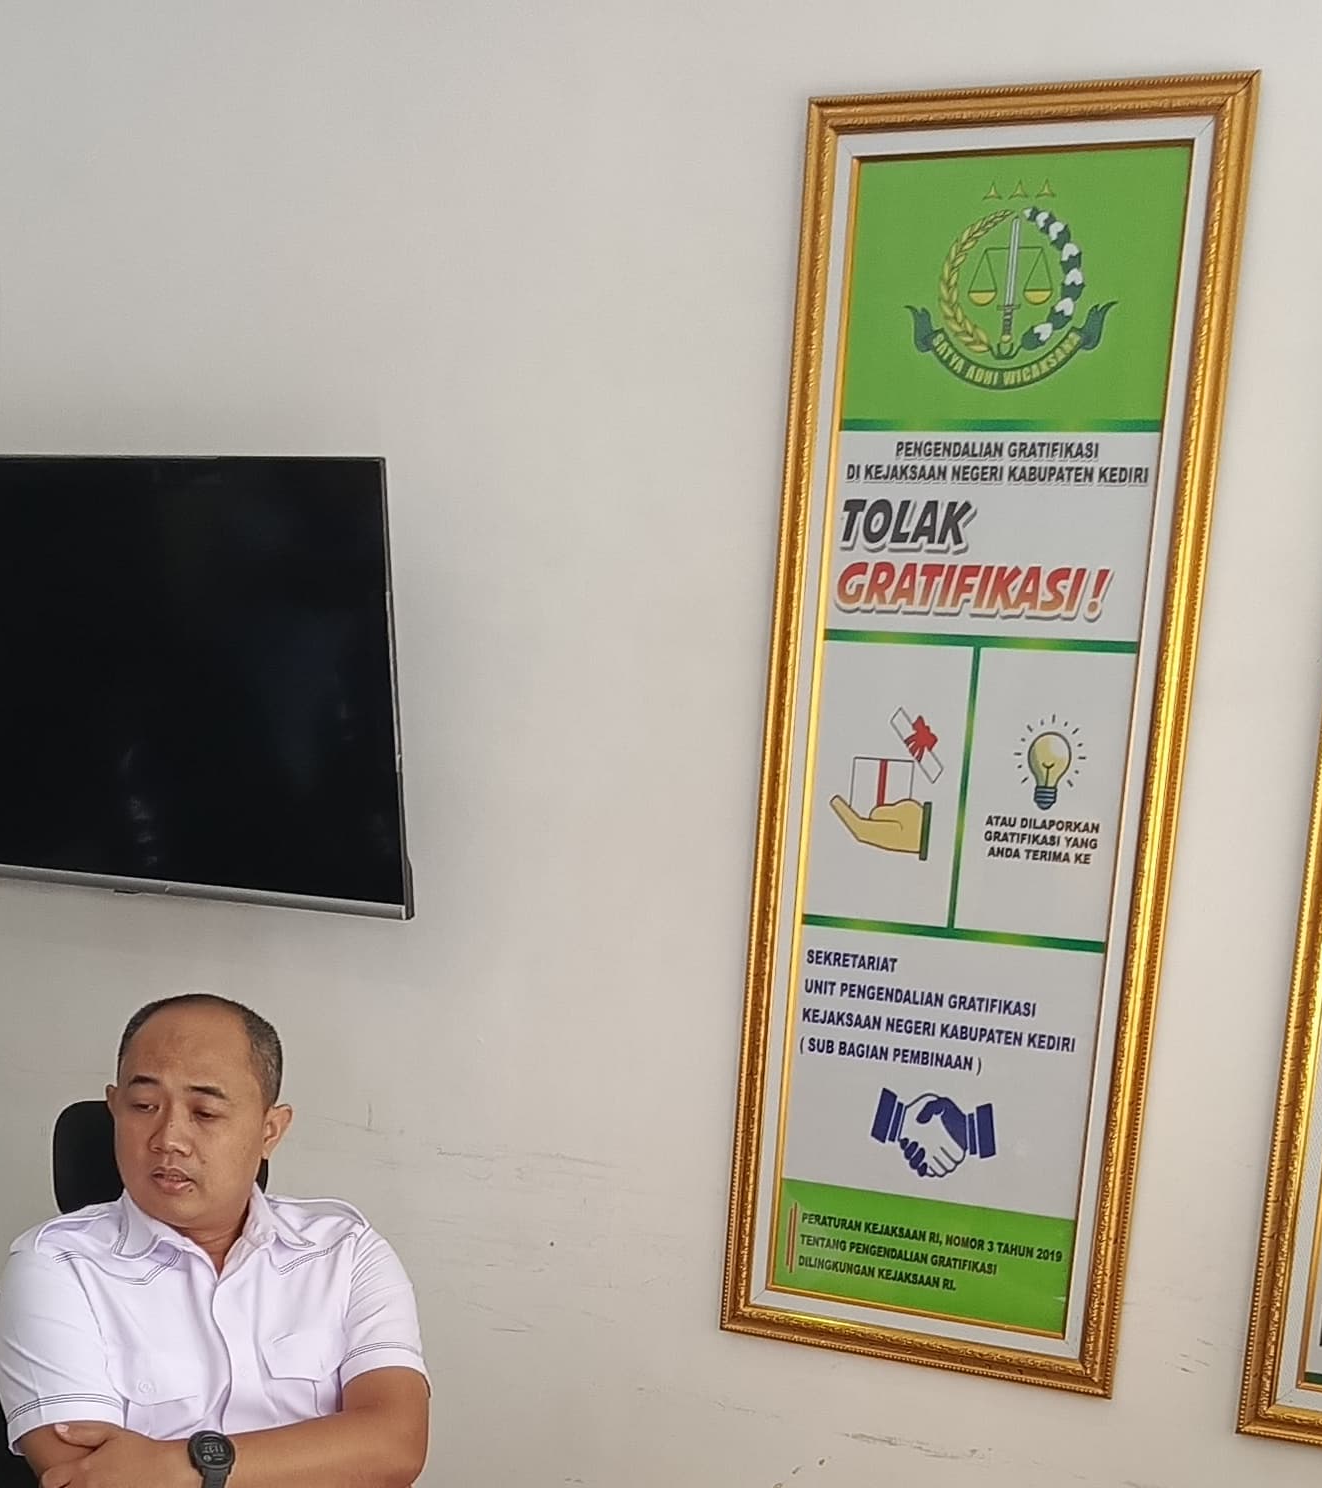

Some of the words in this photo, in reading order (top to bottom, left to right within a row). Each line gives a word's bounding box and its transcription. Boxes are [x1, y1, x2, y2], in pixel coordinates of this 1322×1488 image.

[895, 441, 1004, 458] PENGENDALIAN
[1007, 441, 1099, 459] GRATIFIKASI
[846, 463, 861, 480] DI
[864, 464, 947, 481] KEJAKSAAN
[951, 465, 1004, 482] NEGERI
[1007, 465, 1094, 483] KABUPATEN
[1097, 466, 1149, 484] KEDIRI
[840, 499, 974, 548] TOLAK
[984, 830, 1061, 847] GRATIFIKASI
[1064, 836, 1098, 850] YANG
[985, 815, 1017, 828] ATAU
[1019, 817, 1100, 834] DILAPORKAN
[987, 846, 1021, 859] ANDA
[1024, 848, 1070, 863] TERIMA
[1074, 852, 1091, 865] KE
[806, 949, 898, 972] SEKRETARIAT
[804, 978, 836, 996] UNIT
[839, 982, 944, 1008] PENGENDALIAN
[948, 994, 1036, 1017] GRATIFIKASI
[802, 1007, 882, 1030] KEJAKSAAN
[885, 1017, 936, 1037] NEGERI
[939, 1023, 1023, 1046] KABUPATEN
[1027, 1032, 1075, 1052] KEDIRI
[807, 1037, 834, 1054] SUB
[838, 1040, 889, 1061] BAGIAN
[892, 1047, 973, 1071] PEMBINAAN
[799, 1233, 847, 1252] TENTANG
[849, 1241, 928, 1265] PENGENDALIAN
[930, 1254, 997, 1275] GRATIFIKASI
[801, 1212, 862, 1232] PERATURAN
[863, 1221, 926, 1242] KEJAKSAAN
[928, 1231, 943, 1247] RI,
[945, 1234, 985, 1251] NOMOR
[987, 1240, 994, 1252] 3
[996, 1241, 1034, 1258] TAHUN
[1036, 1247, 1062, 1262] 2019
[798, 1254, 876, 1278] DILINGKUNGAN
[877, 1267, 940, 1288] KEJAKSAAN
[942, 1277, 956, 1291] RI.
